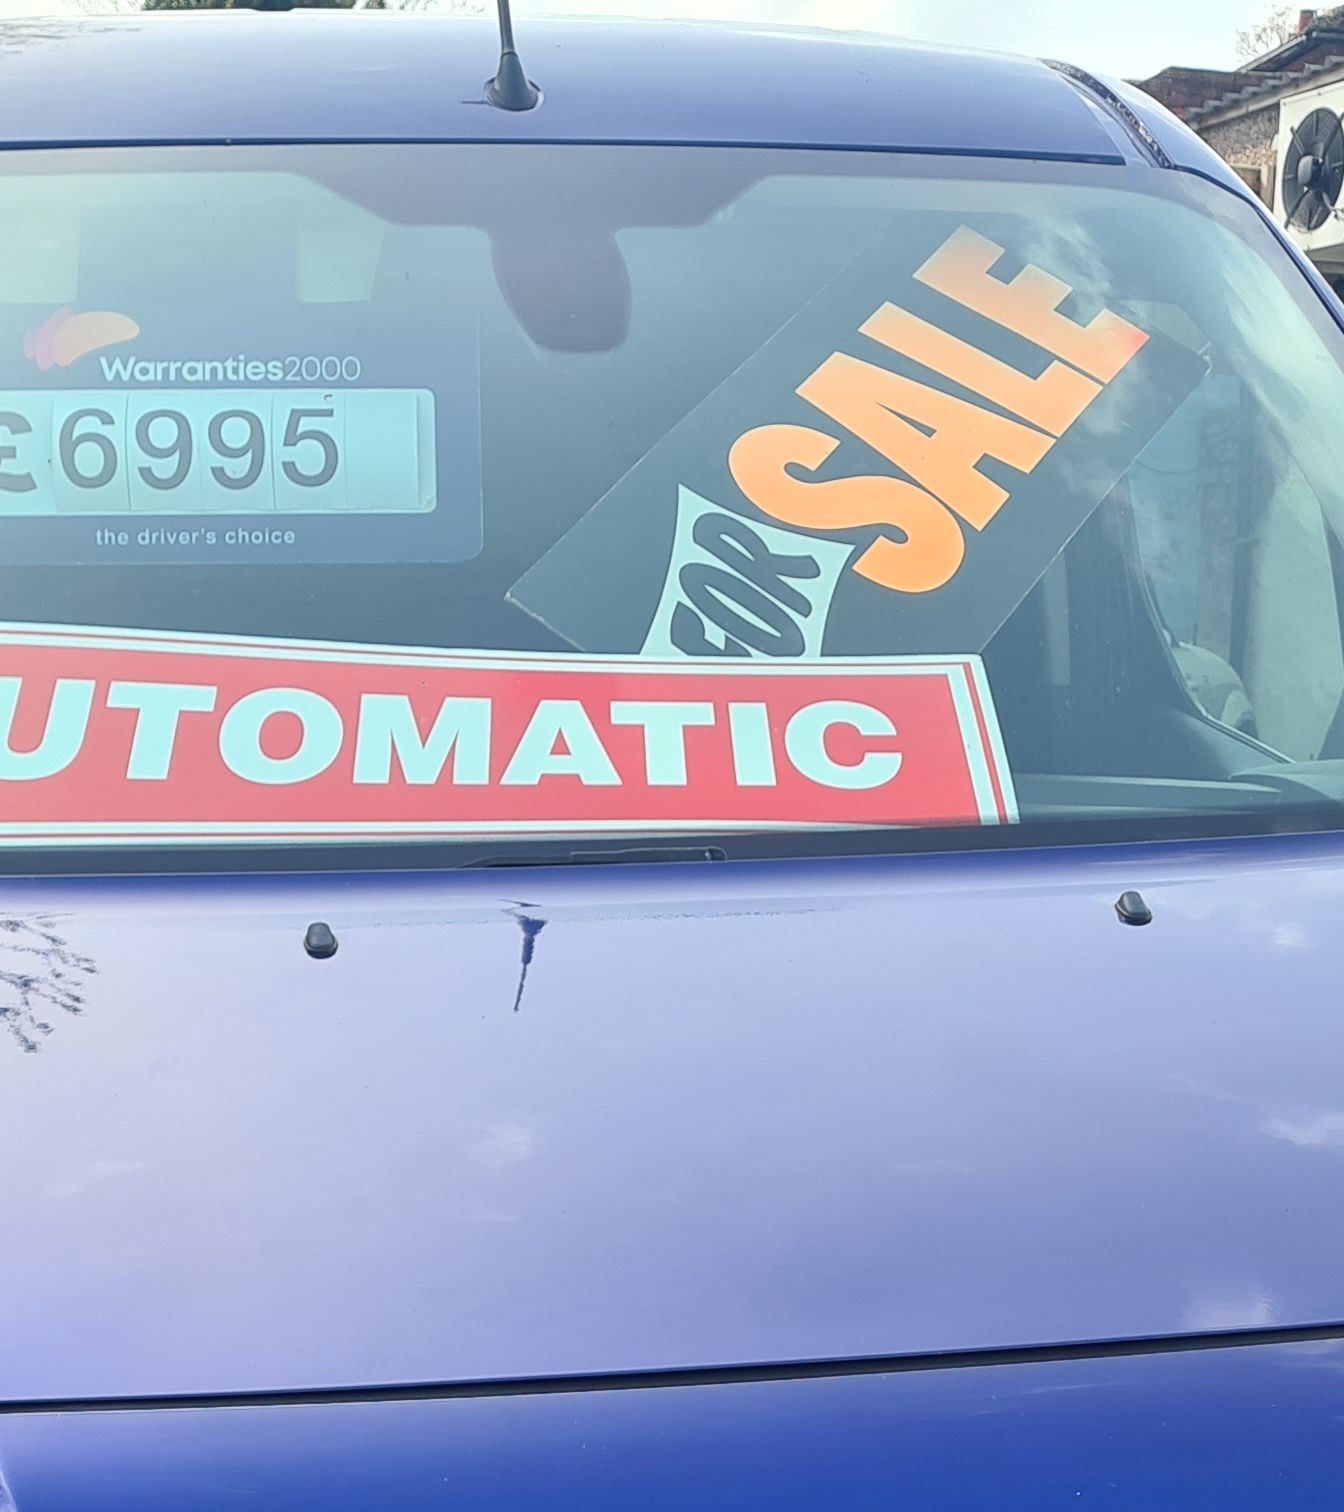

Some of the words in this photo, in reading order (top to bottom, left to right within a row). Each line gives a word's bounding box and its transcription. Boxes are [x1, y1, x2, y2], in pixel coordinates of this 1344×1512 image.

[100, 354, 361, 382] Warranties2000
[727, 224, 1150, 593] SALE
[95, 528, 129, 545] the
[137, 528, 217, 545] driver's
[224, 527, 296, 545] choice
